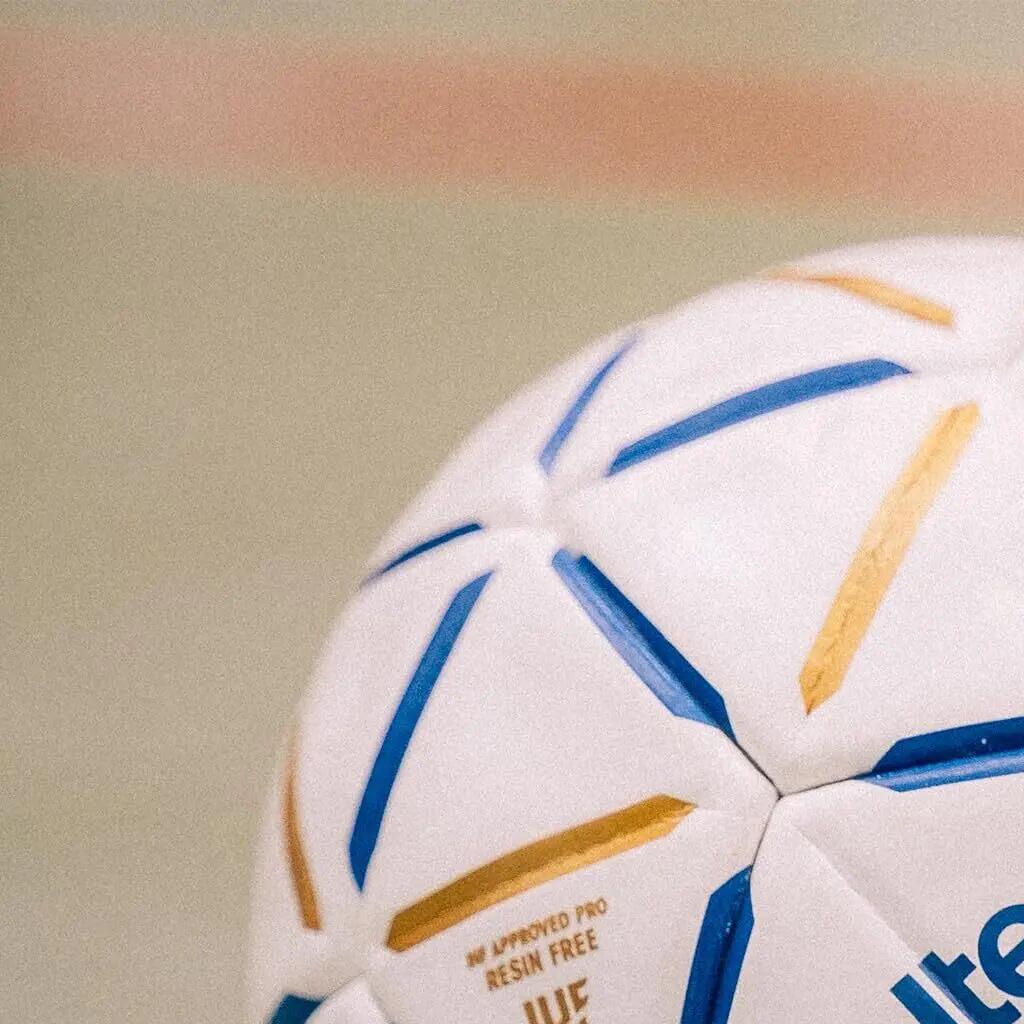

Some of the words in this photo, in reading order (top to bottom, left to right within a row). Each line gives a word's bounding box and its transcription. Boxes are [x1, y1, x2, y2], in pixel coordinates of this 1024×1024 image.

[576, 897, 608, 923] PRO
[485, 951, 543, 991] RESIN
[548, 928, 599, 966] FREE
